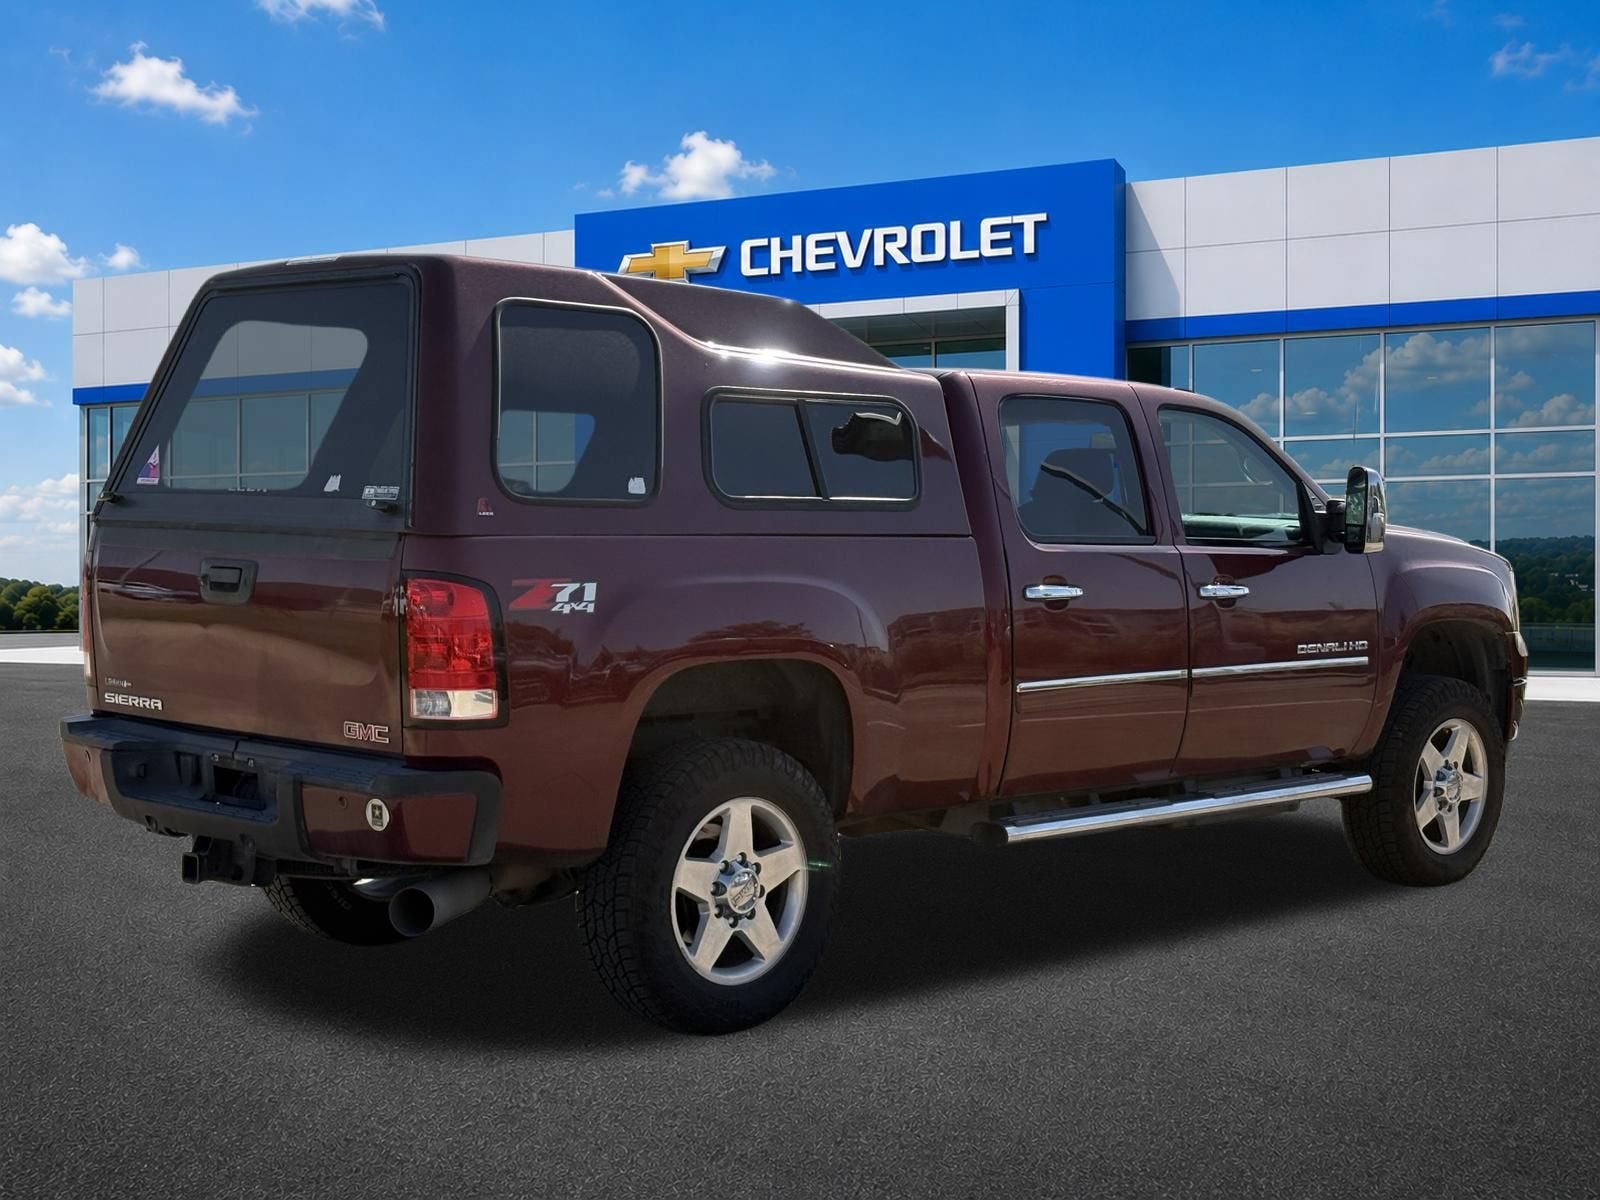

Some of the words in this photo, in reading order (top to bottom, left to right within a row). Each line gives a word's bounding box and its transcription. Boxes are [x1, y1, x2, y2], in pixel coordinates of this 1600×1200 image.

[740, 212, 1047, 276] CHEVROLET
[509, 578, 597, 611] Z71
[1297, 642, 1347, 654] DENALI
[1349, 640, 1368, 651] HD
[104, 692, 163, 710] SIERRA
[343, 720, 389, 743] GMC
